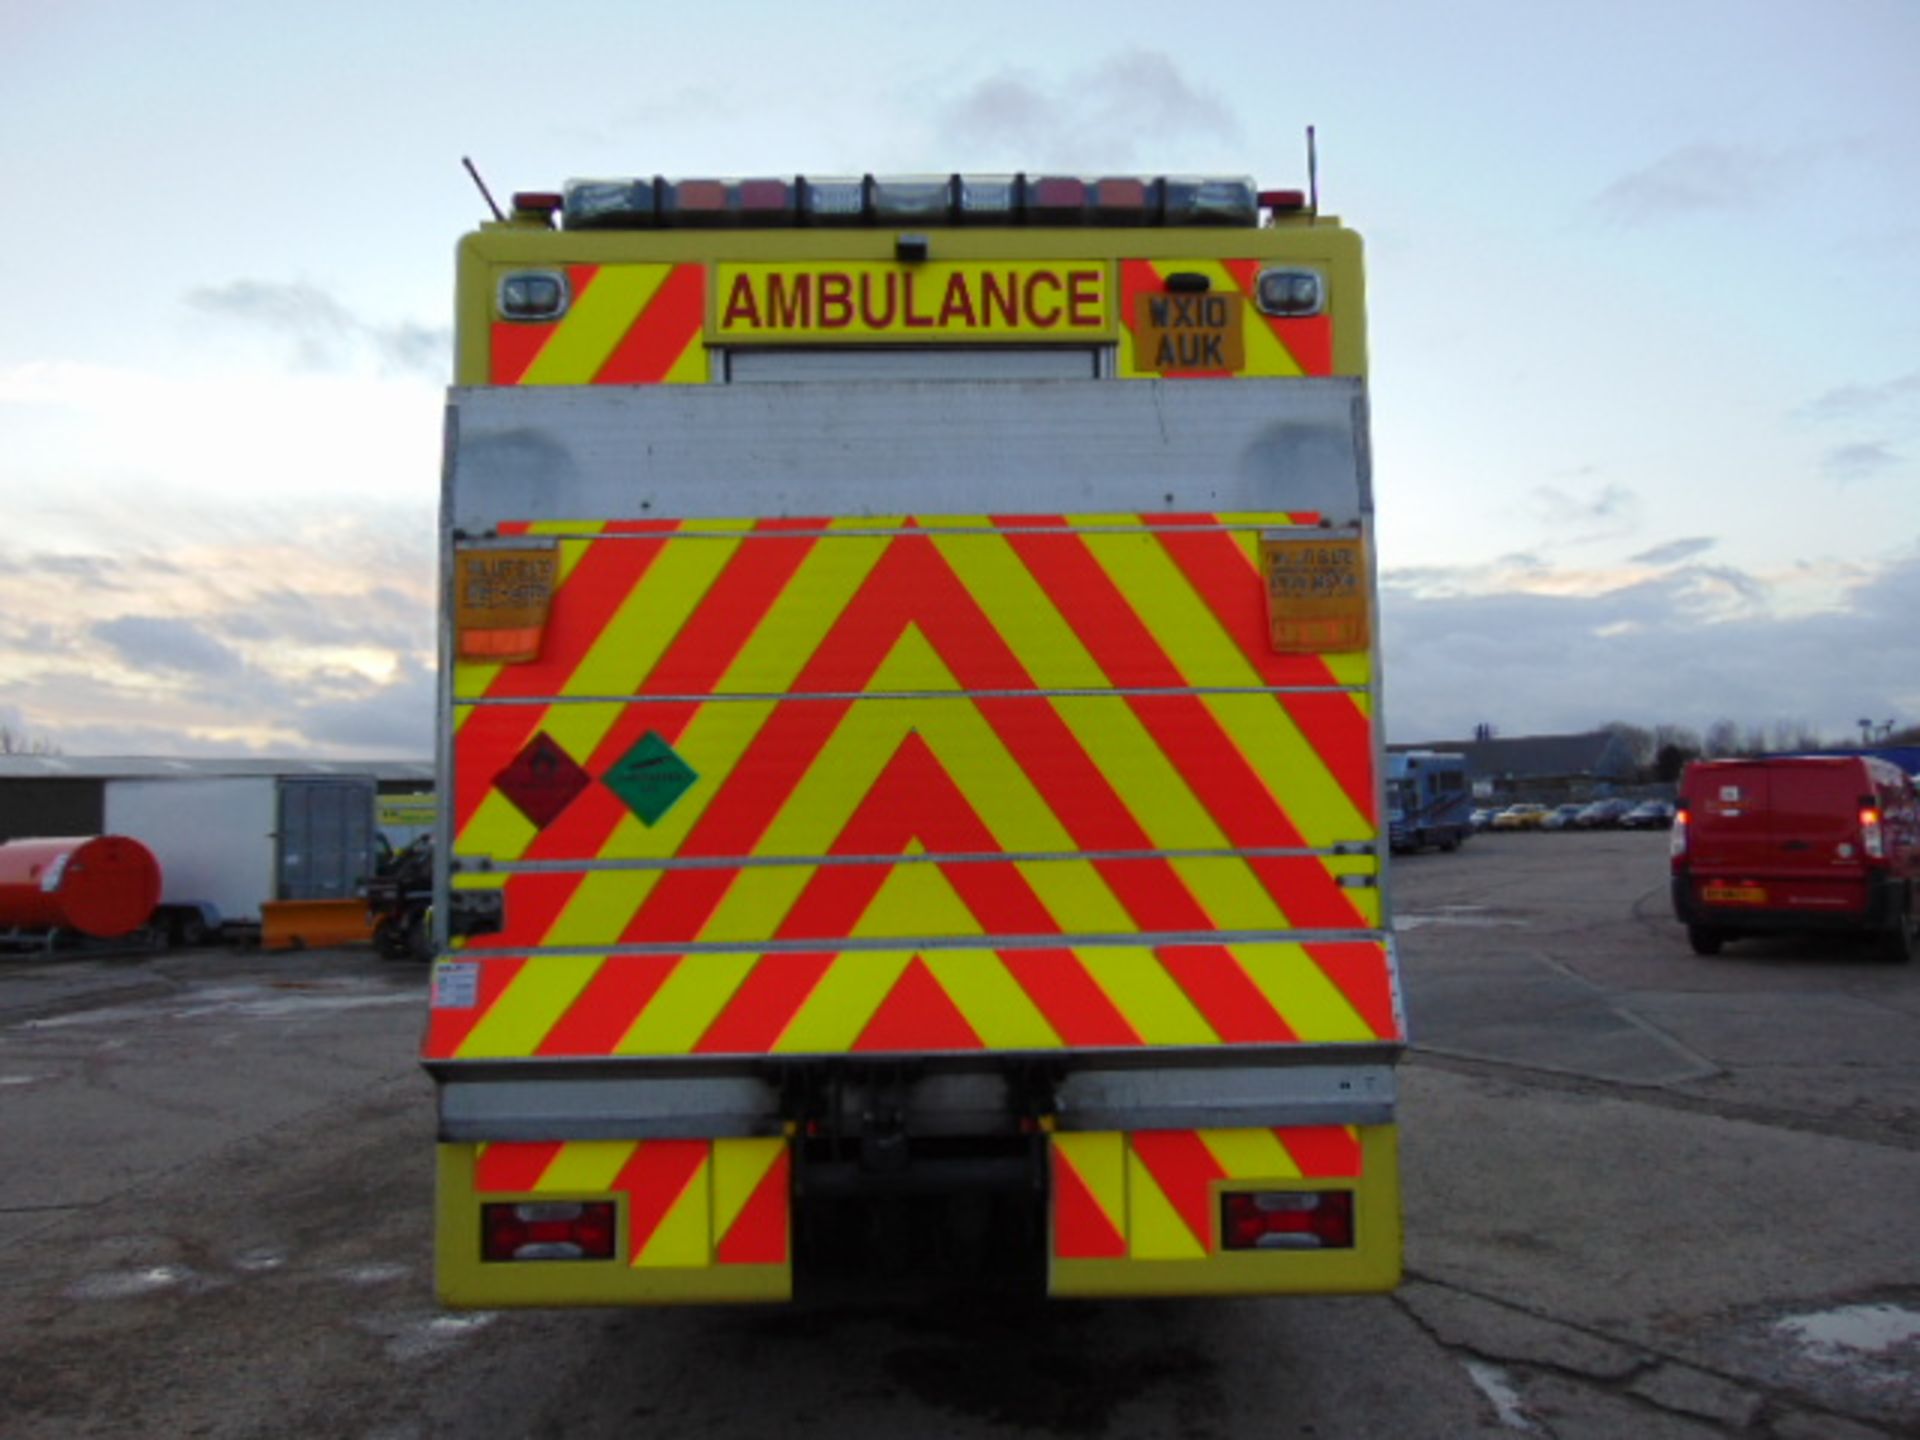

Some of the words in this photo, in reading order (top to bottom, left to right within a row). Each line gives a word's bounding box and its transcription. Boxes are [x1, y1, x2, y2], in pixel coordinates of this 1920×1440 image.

[723, 270, 1102, 328] AMBULANCE
[1149, 298, 1227, 327] WX10
[1156, 335, 1224, 366] AUK
